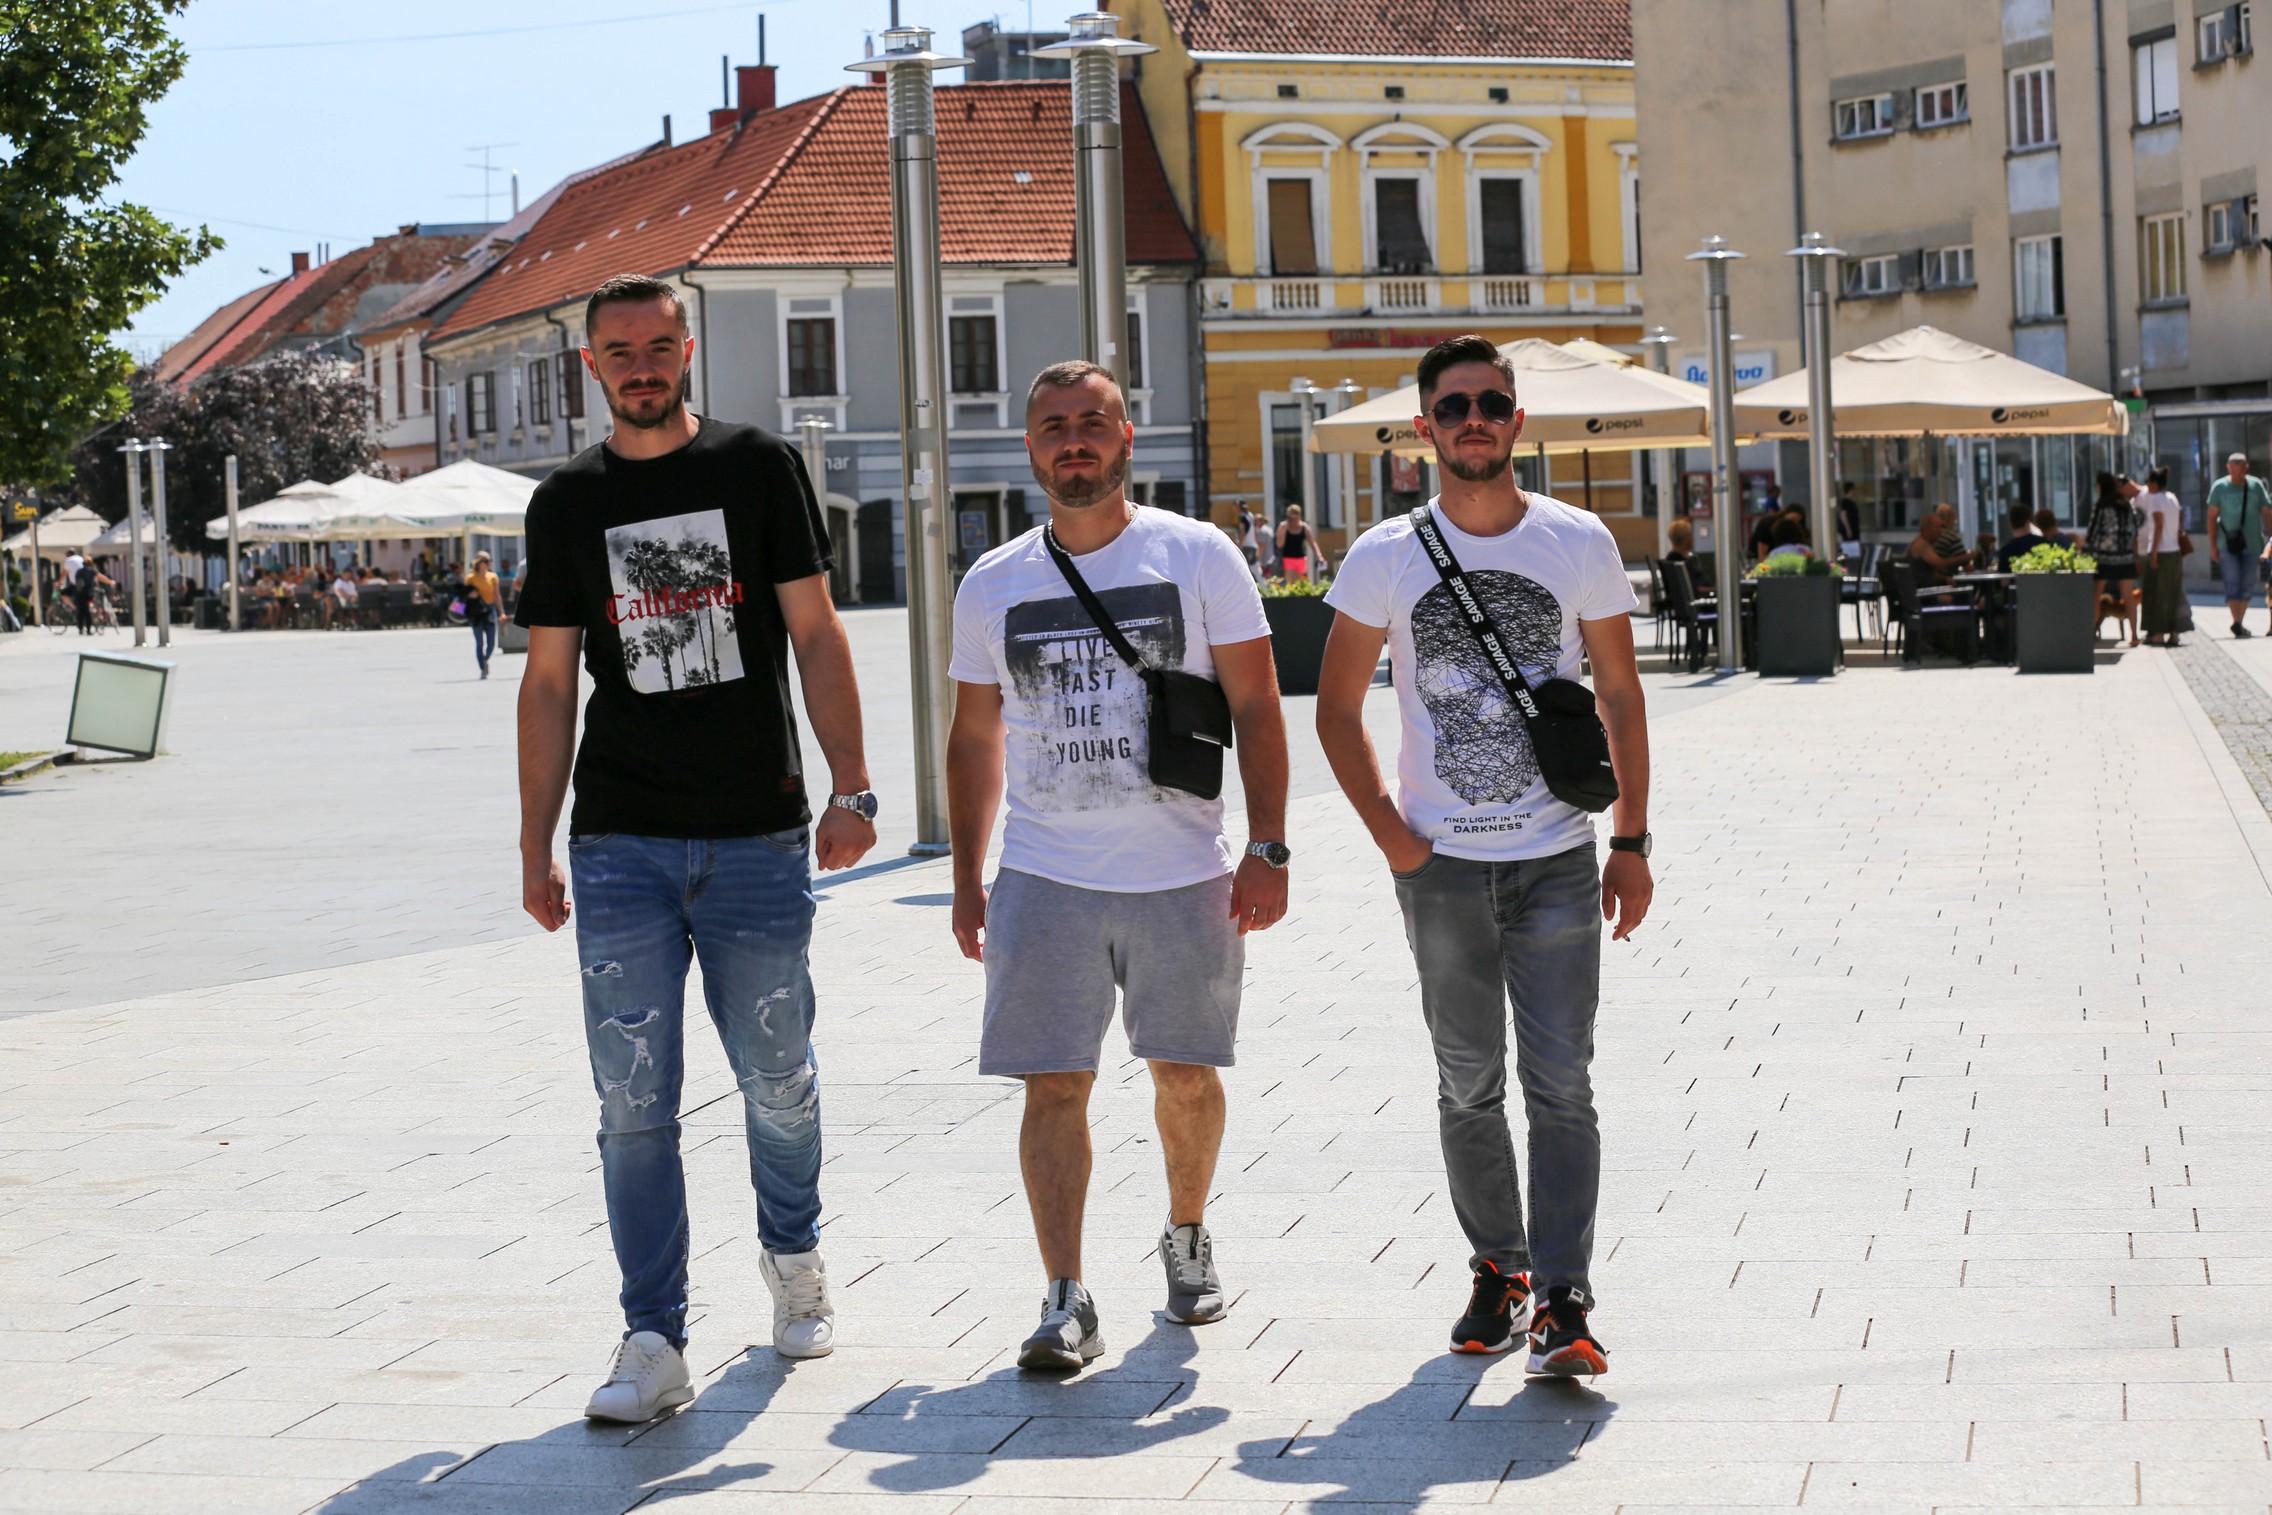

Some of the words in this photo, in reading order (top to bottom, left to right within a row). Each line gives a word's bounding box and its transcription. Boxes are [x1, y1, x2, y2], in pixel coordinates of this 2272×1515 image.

[1605, 417, 1644, 431] pepsi
[2010, 407, 2050, 420] pepsi
[1420, 524, 1451, 567] SAVAGE
[606, 577, 744, 625] California
[1449, 576, 1485, 623] SAVAGE
[1061, 637, 1114, 664] LIVE
[1482, 632, 1517, 680] SAVAGE
[1060, 669, 1117, 695] FAST
[1066, 704, 1102, 728] DIE
[1056, 736, 1131, 764] YOUNG
[1453, 821, 1523, 833] DARKNESS
[1469, 816, 1498, 824] LIGHT
[1513, 812, 1532, 820] THE
